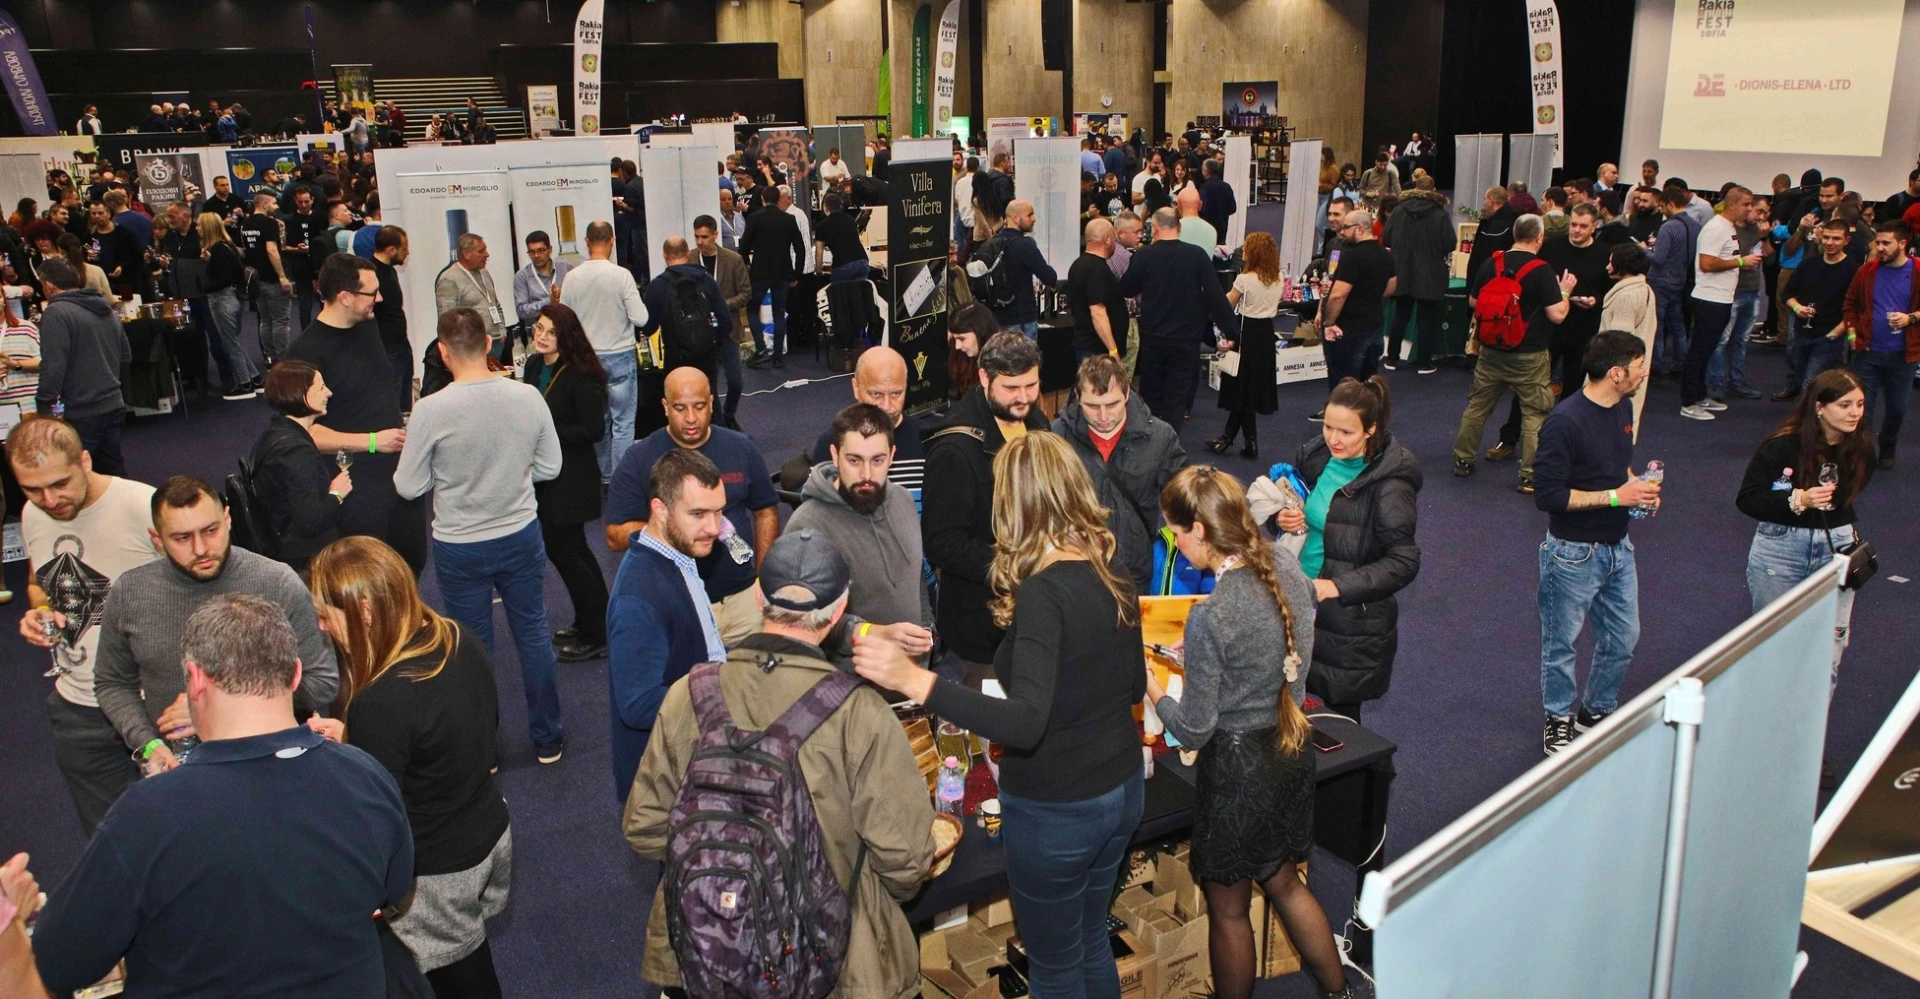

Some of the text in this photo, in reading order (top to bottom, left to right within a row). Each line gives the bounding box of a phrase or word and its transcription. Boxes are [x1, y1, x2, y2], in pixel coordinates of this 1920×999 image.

[1699, 0, 1735, 11] Rakia
[580, 20, 602, 29] Rakia
[942, 21, 957, 29] Rakia
[1696, 16, 1733, 29] FEST
[580, 31, 601, 39] FEST
[941, 31, 956, 39] FEST
[1700, 30, 1726, 38] SOFIA
[938, 76, 953, 84] Rakia
[579, 82, 599, 90] Rakia
[1829, 79, 1852, 91] LTD
[579, 92, 599, 100] FEST
[910, 172, 933, 192] Villa
[448, 184, 462, 195] EM
[902, 197, 942, 218] Vinifera
[1283, 363, 1305, 371] AMNESIA
[1309, 360, 1328, 368] AMNES
[1121, 970, 1143, 985] GILE
